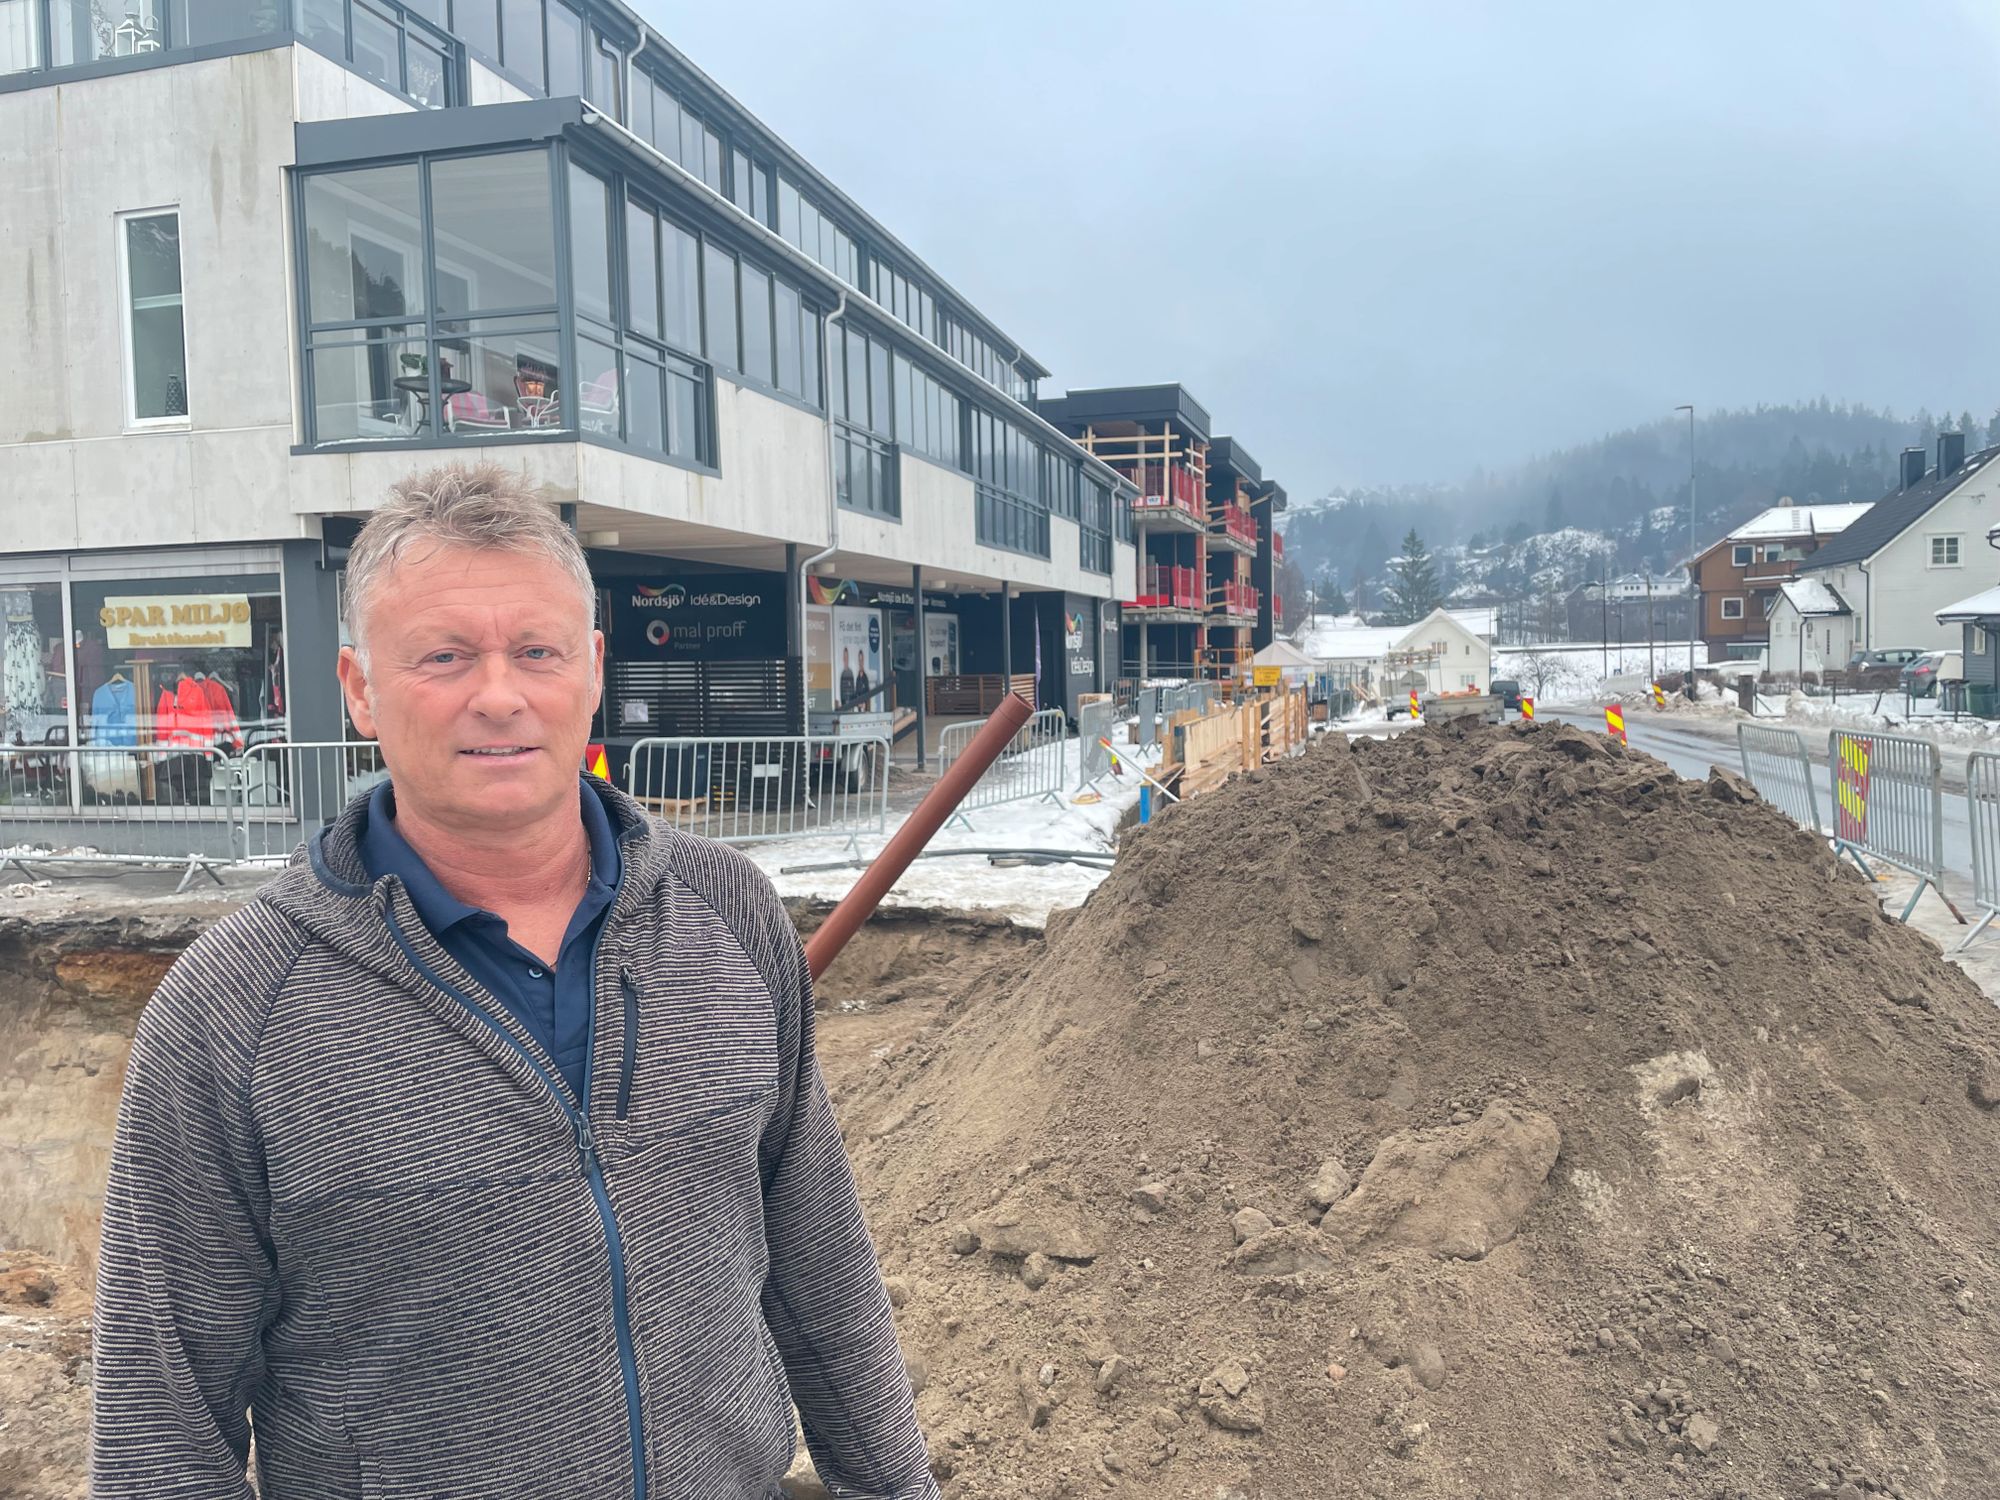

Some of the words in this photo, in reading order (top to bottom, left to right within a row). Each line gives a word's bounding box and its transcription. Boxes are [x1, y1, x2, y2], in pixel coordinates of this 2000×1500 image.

[631, 594, 681, 609] Nordsjö
[99, 606, 166, 627] SPAR
[170, 602, 250, 624] MILJØ
[673, 621, 701, 638] mal
[706, 620, 747, 641] proff
